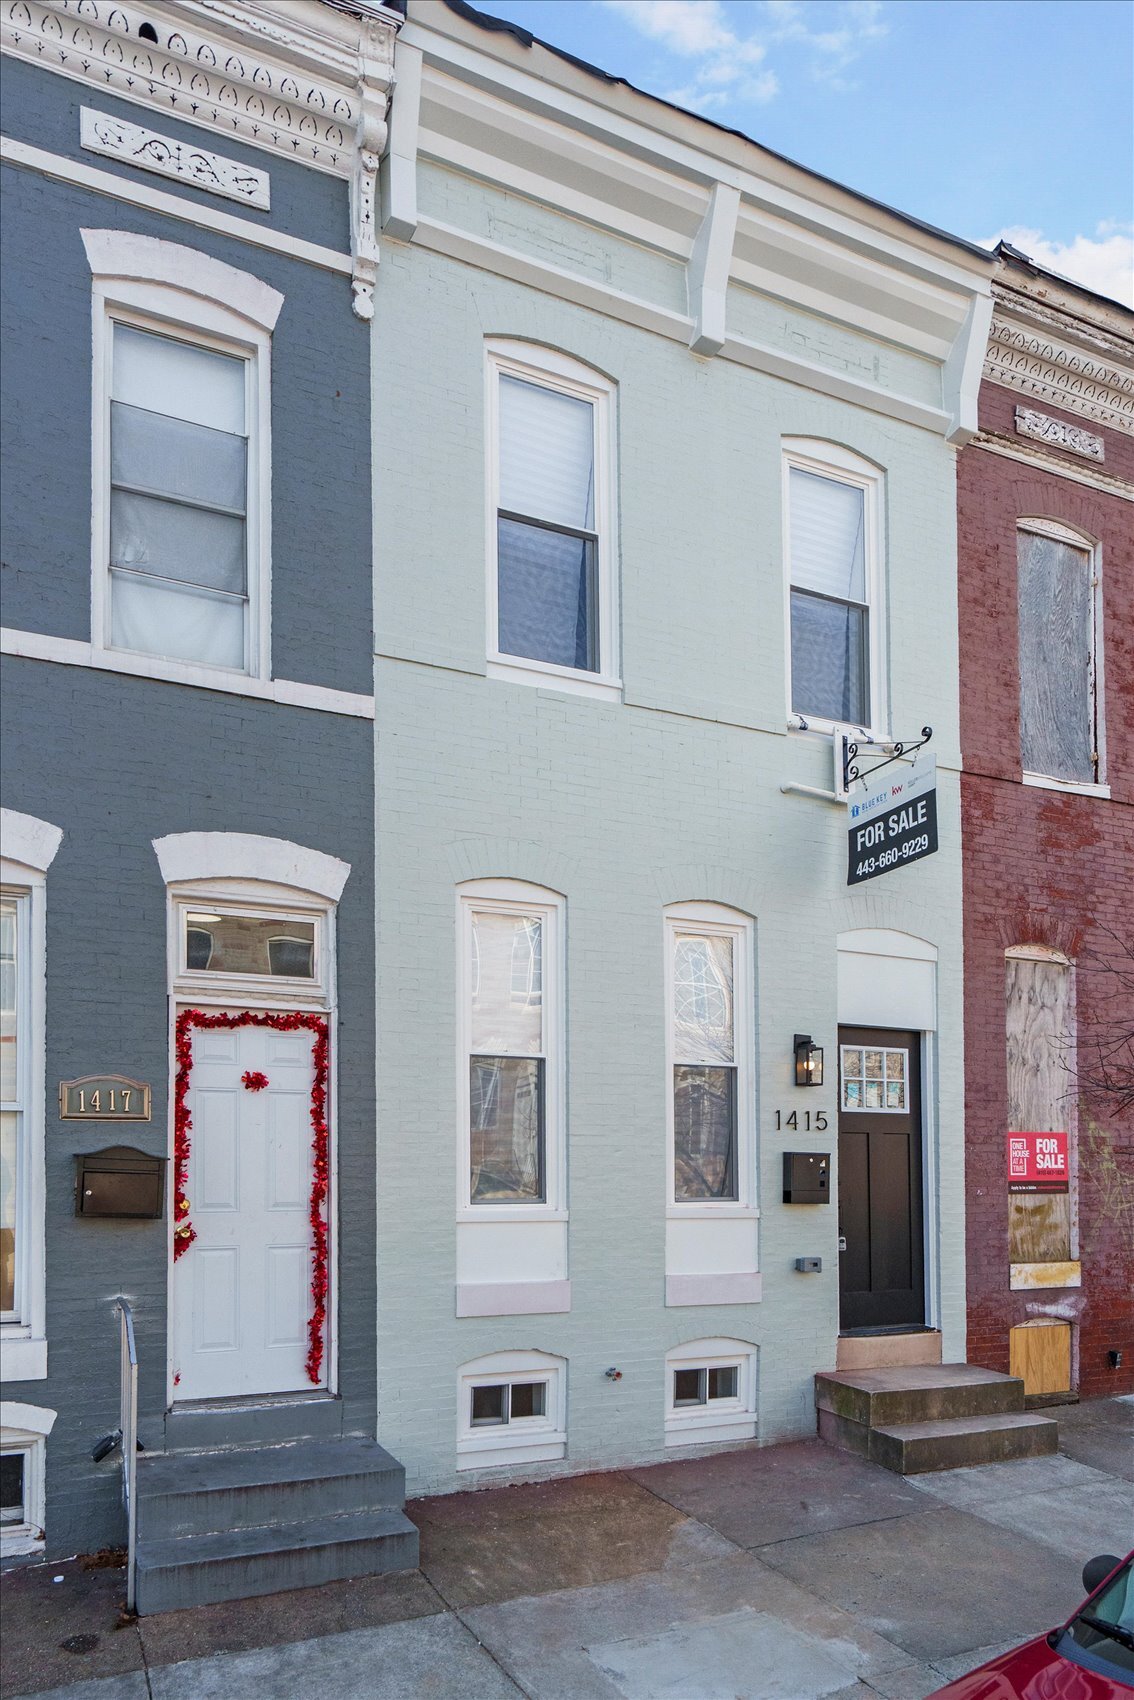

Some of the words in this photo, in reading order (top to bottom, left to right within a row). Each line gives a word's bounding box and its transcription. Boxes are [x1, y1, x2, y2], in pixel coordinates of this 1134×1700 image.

[862, 797, 876, 811] BLUE
[876, 791, 888, 803] KEY
[856, 821, 885, 852] FOR
[888, 800, 928, 837] SALE
[856, 833, 929, 876] 443-660-9229
[79, 1089, 131, 1112] 1417
[775, 1109, 828, 1131] 1415
[1012, 1142, 1023, 1150] ONE
[1012, 1150, 1030, 1158] HOUSE
[1036, 1138, 1058, 1153] FOR
[1036, 1154, 1065, 1168] SALE
